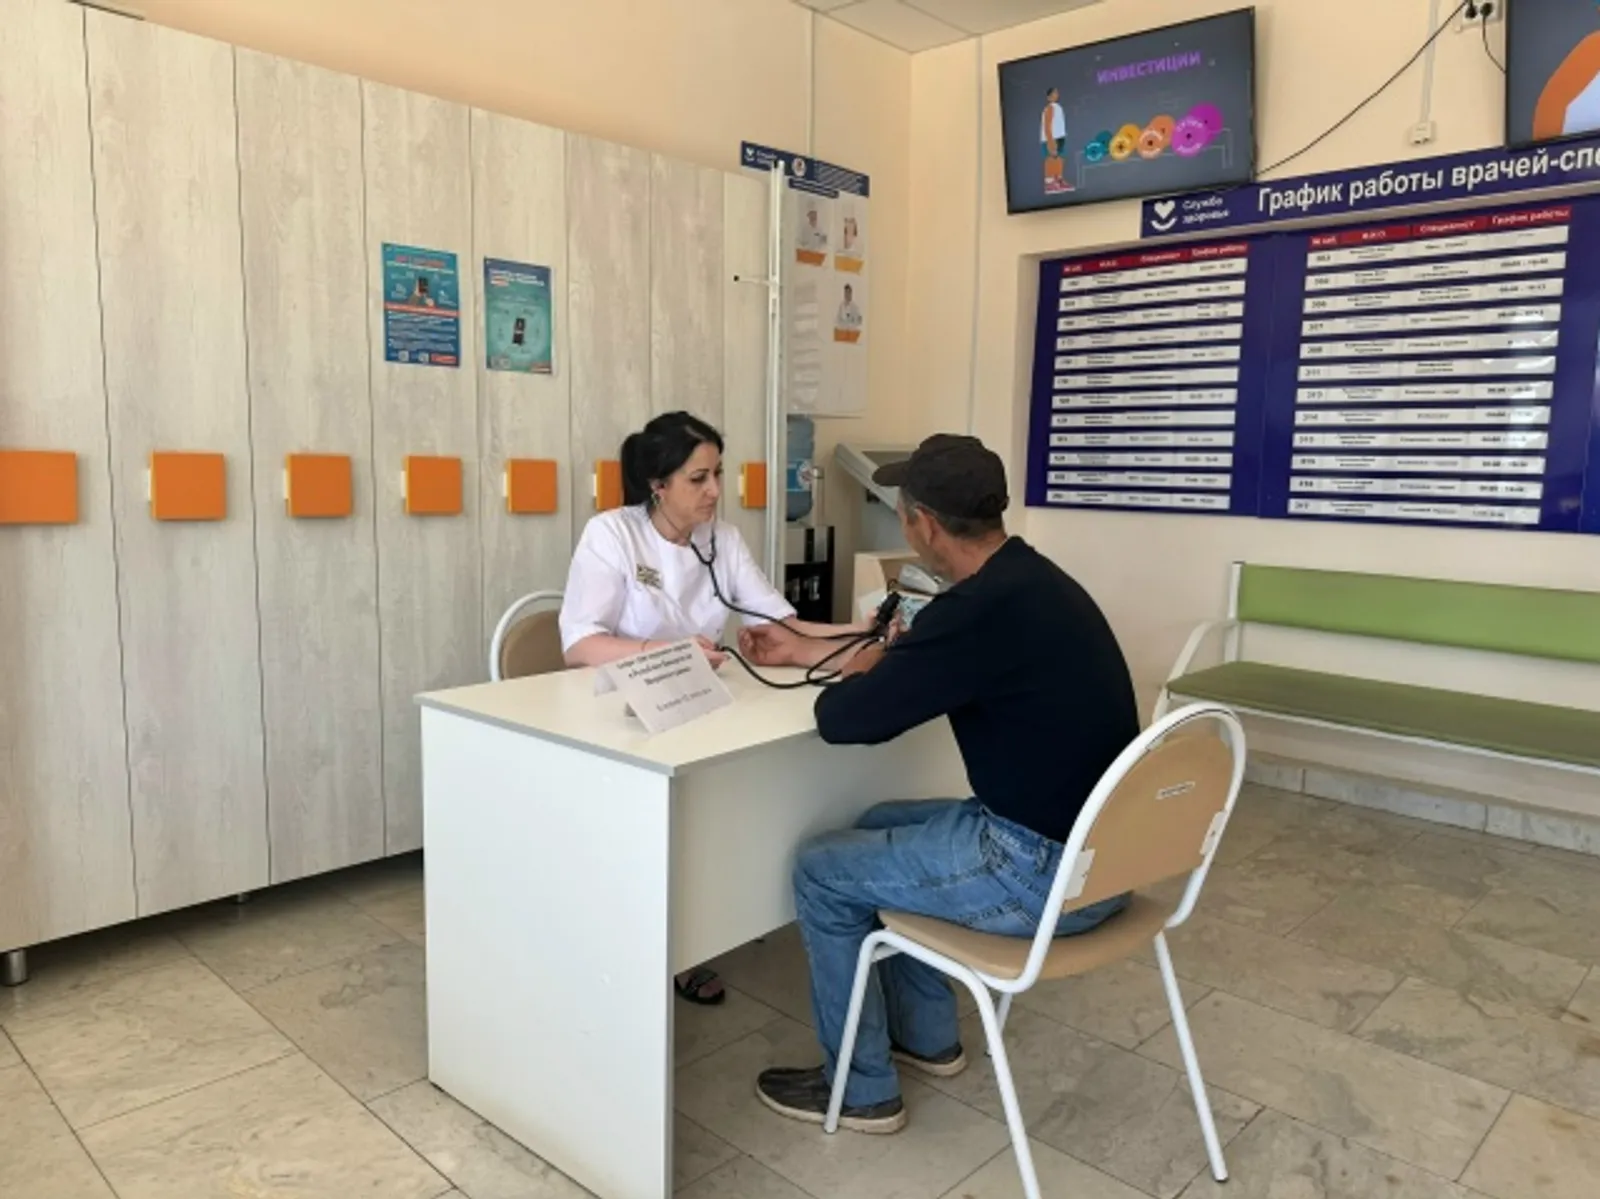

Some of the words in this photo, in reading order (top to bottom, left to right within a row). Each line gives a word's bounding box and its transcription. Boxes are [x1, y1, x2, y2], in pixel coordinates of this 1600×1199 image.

[1096, 52, 1202, 84] ИНВЕСТИЦИИ
[1258, 181, 1344, 216] График
[1349, 168, 1443, 206] работы
[1182, 195, 1224, 210] Служба
[1182, 208, 1230, 224] здоровья
[1491, 213, 1528, 226] График
[1529, 209, 1569, 222] работы
